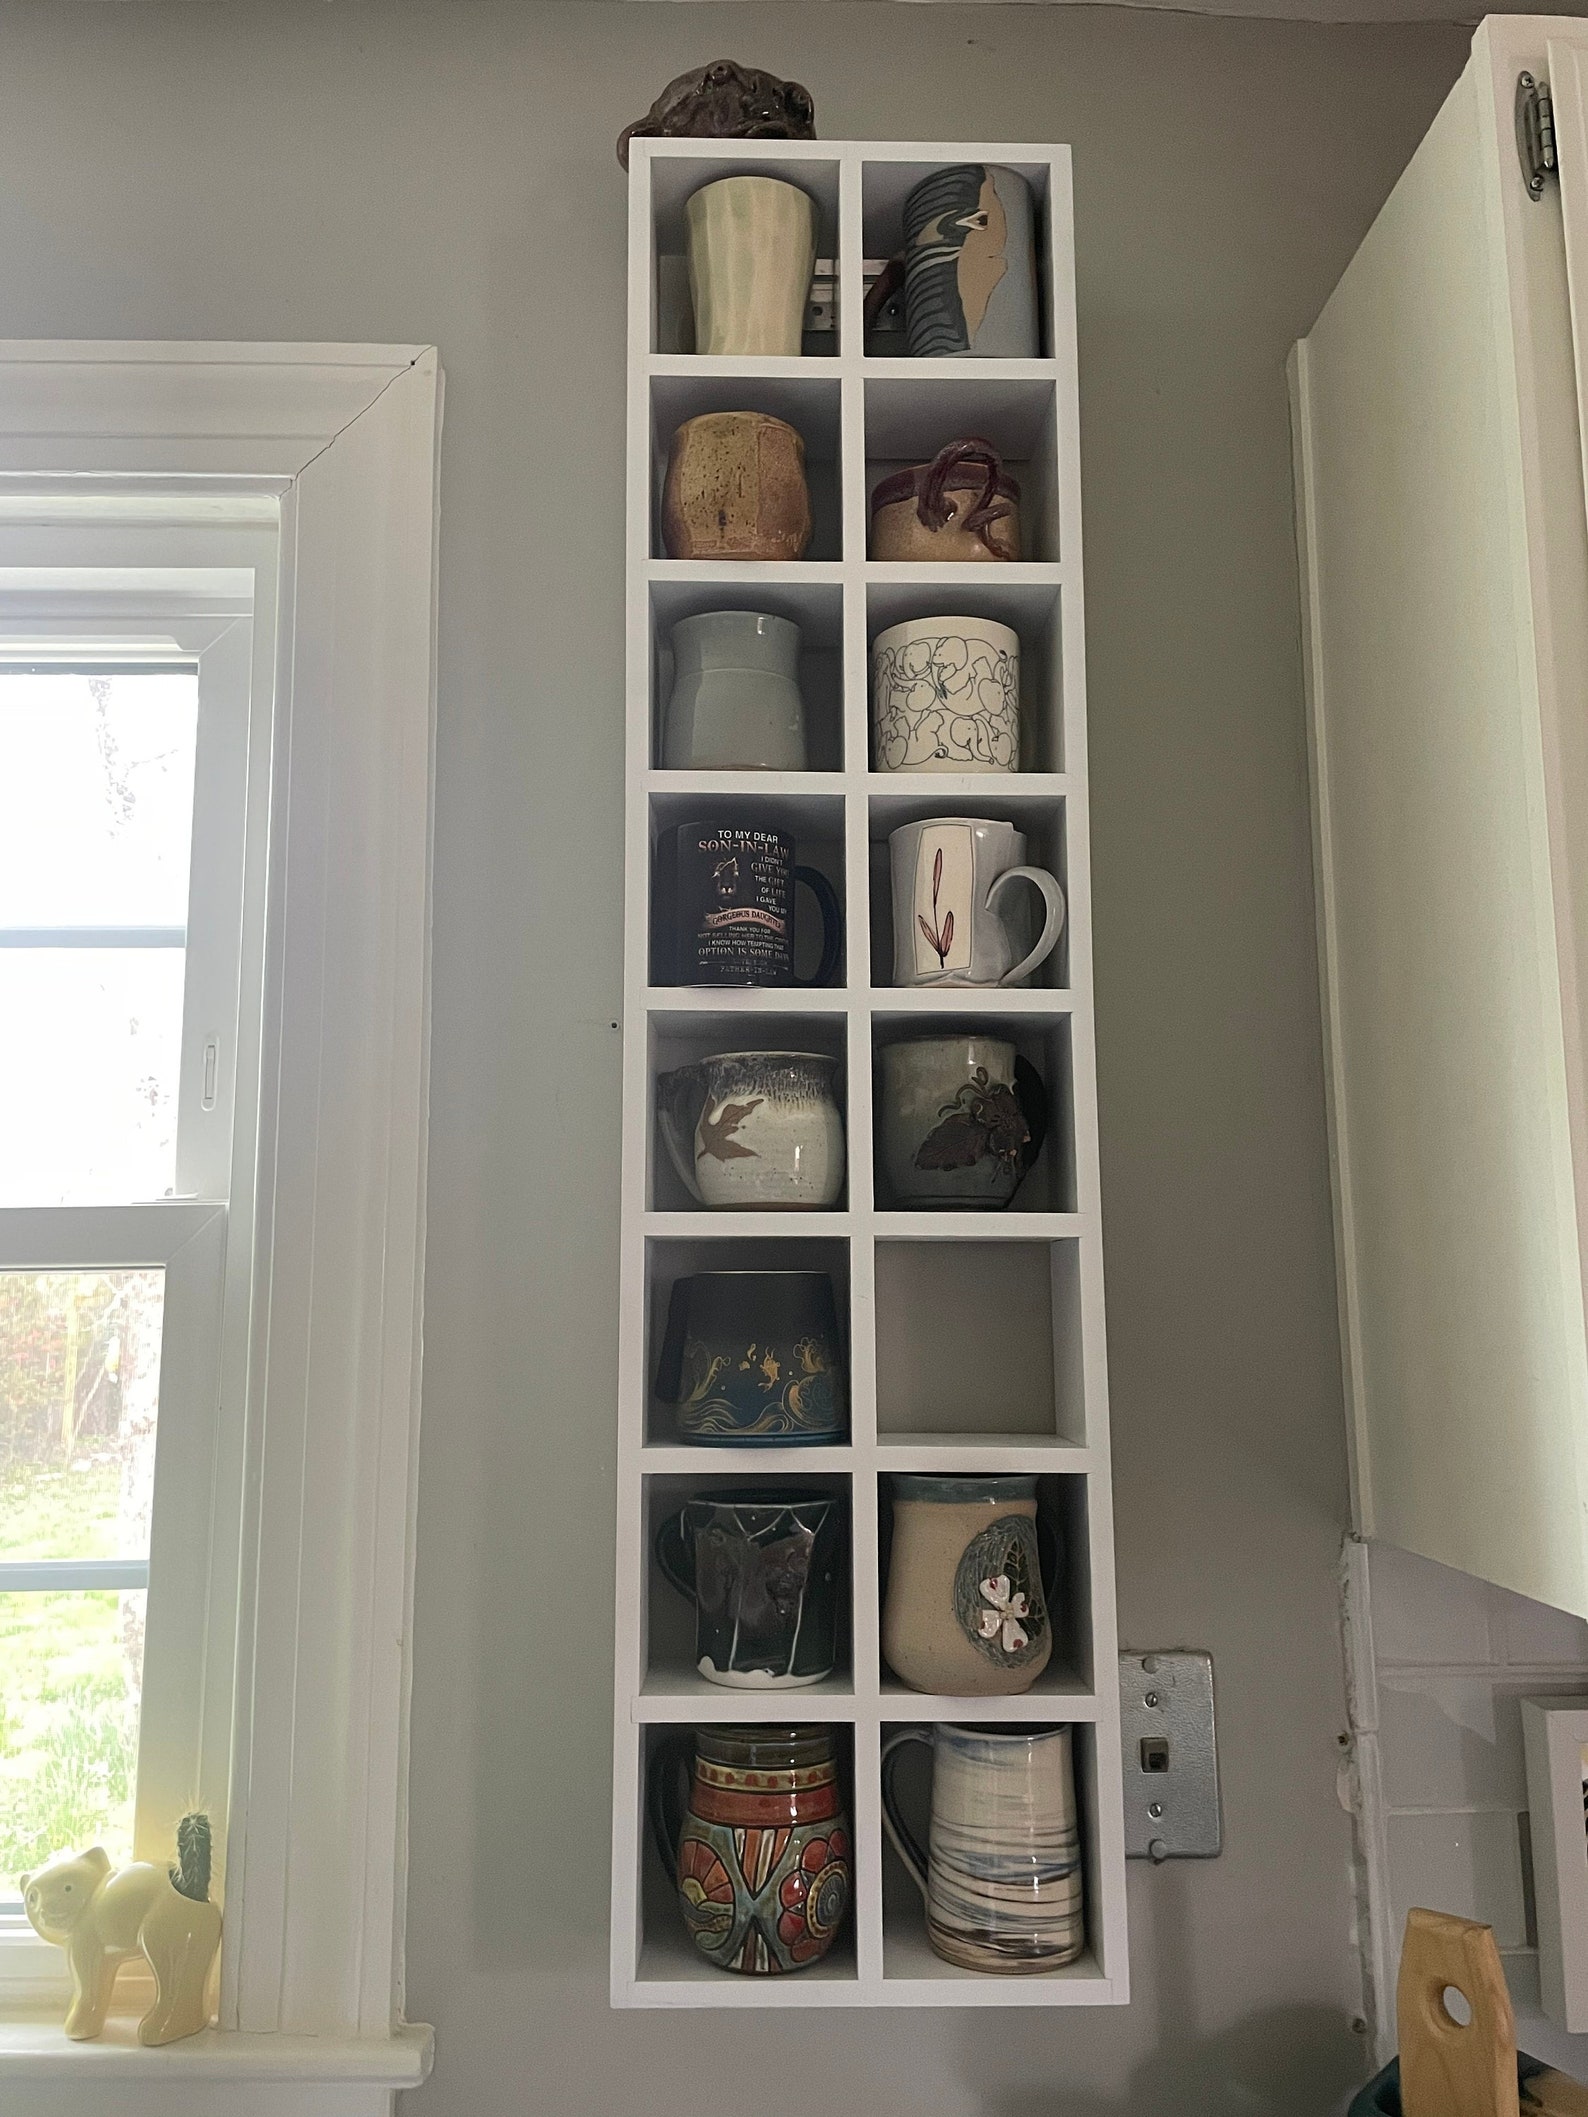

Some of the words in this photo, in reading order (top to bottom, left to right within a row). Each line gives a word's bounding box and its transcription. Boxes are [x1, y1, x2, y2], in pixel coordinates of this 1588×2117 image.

[718, 830, 732, 839] TO
[735, 830, 750, 839] MY
[754, 832, 778, 844] DEAR
[698, 840, 789, 859] SON-IN-LAW
[751, 862, 773, 874] GIVE
[754, 875, 766, 883] THE
[768, 877, 784, 887] GIFT
[771, 888, 786, 899] LIFE
[760, 896, 776, 905] GAVE
[768, 906, 780, 914] YOU
[713, 910, 750, 926] GORGEOUS
[747, 940, 774, 948] TEMPTING
[698, 947, 734, 956] OPTION
[738, 947, 747, 955] IS
[749, 948, 772, 959] SOME
